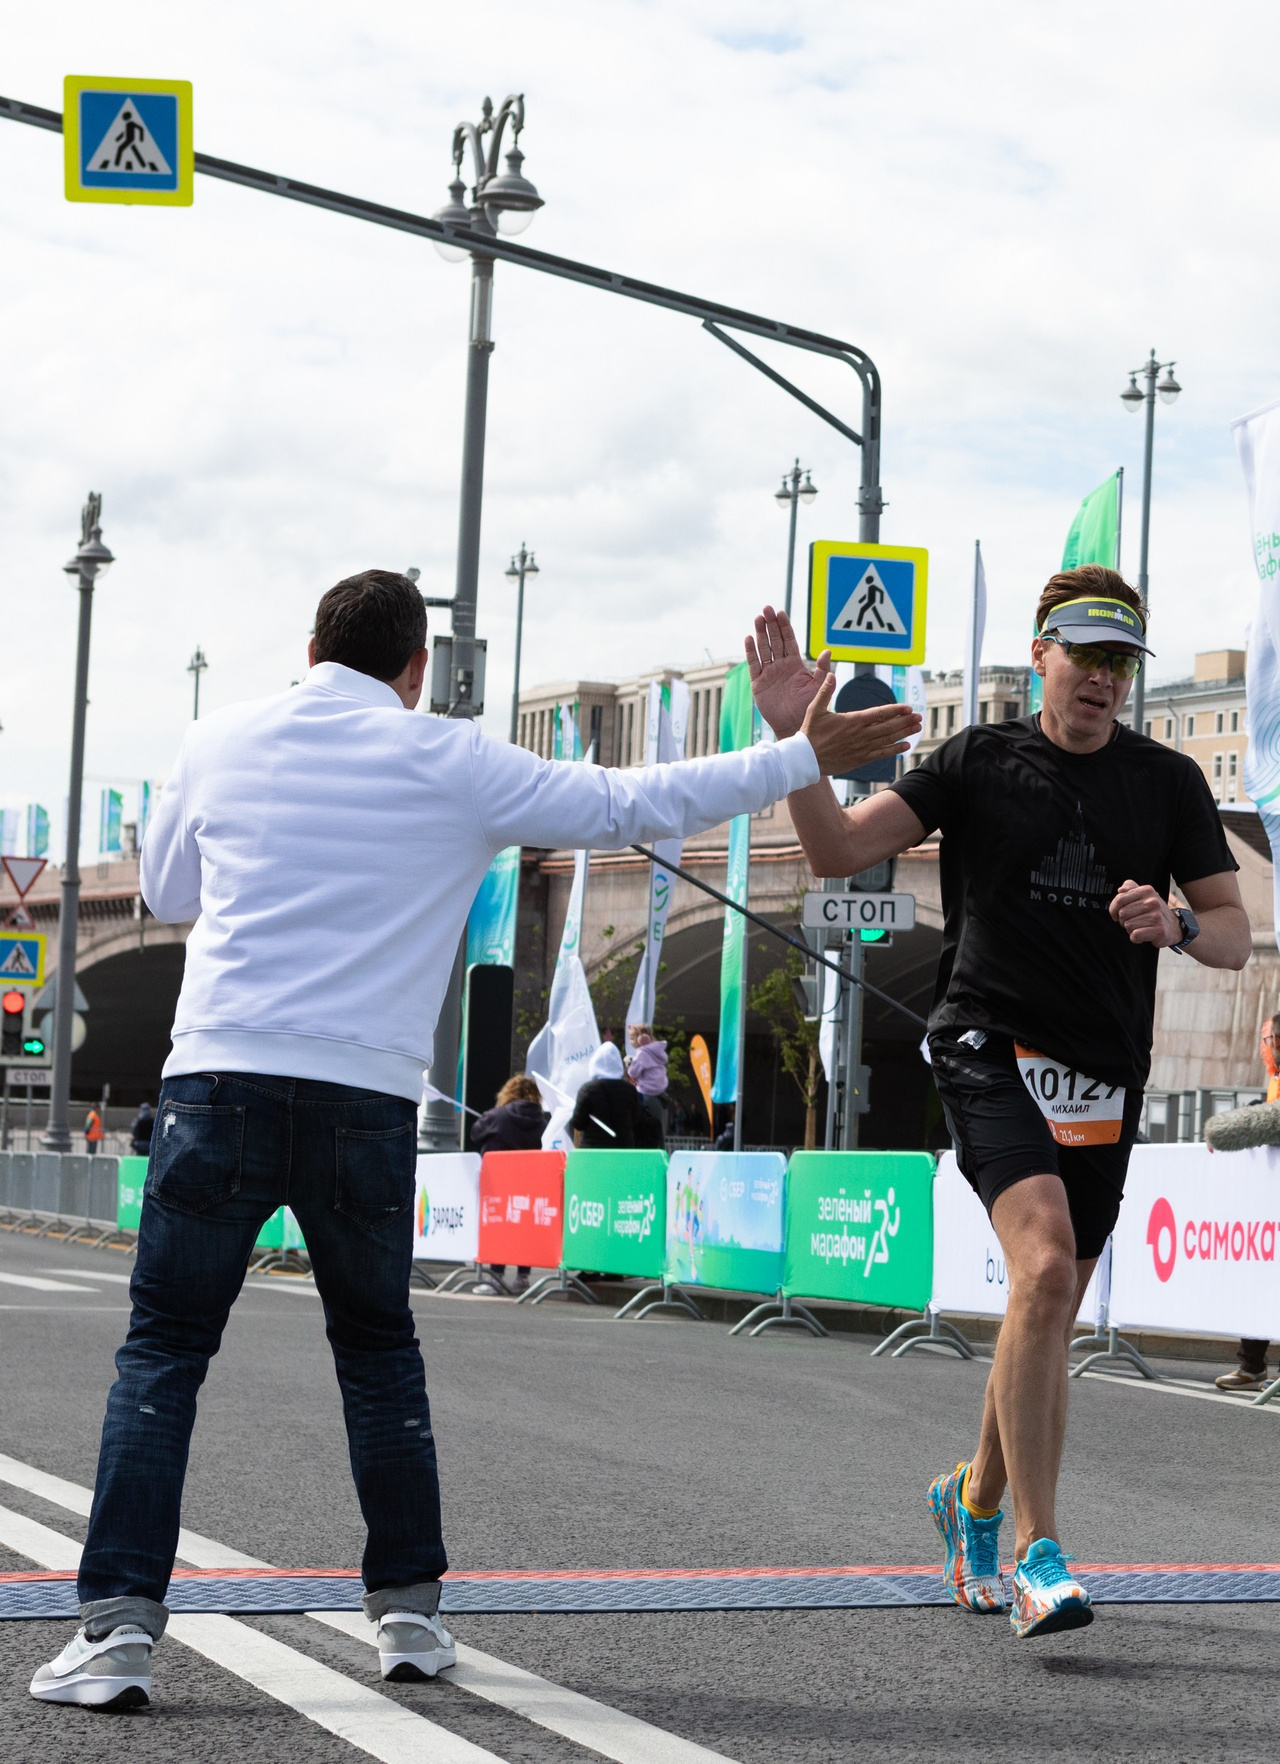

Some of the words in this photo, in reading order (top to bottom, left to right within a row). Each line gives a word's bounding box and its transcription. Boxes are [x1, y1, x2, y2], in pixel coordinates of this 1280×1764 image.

[1088, 608, 1134, 627] IRONMAN
[823, 898, 896, 923] СТОП
[1030, 889, 1109, 910] МОСКВ
[13, 1071, 47, 1082] СТОП
[580, 1201, 605, 1228] СБЕР
[818, 1188, 872, 1224] зелёный
[811, 1225, 866, 1267] марафон
[985, 1247, 1007, 1286] bu
